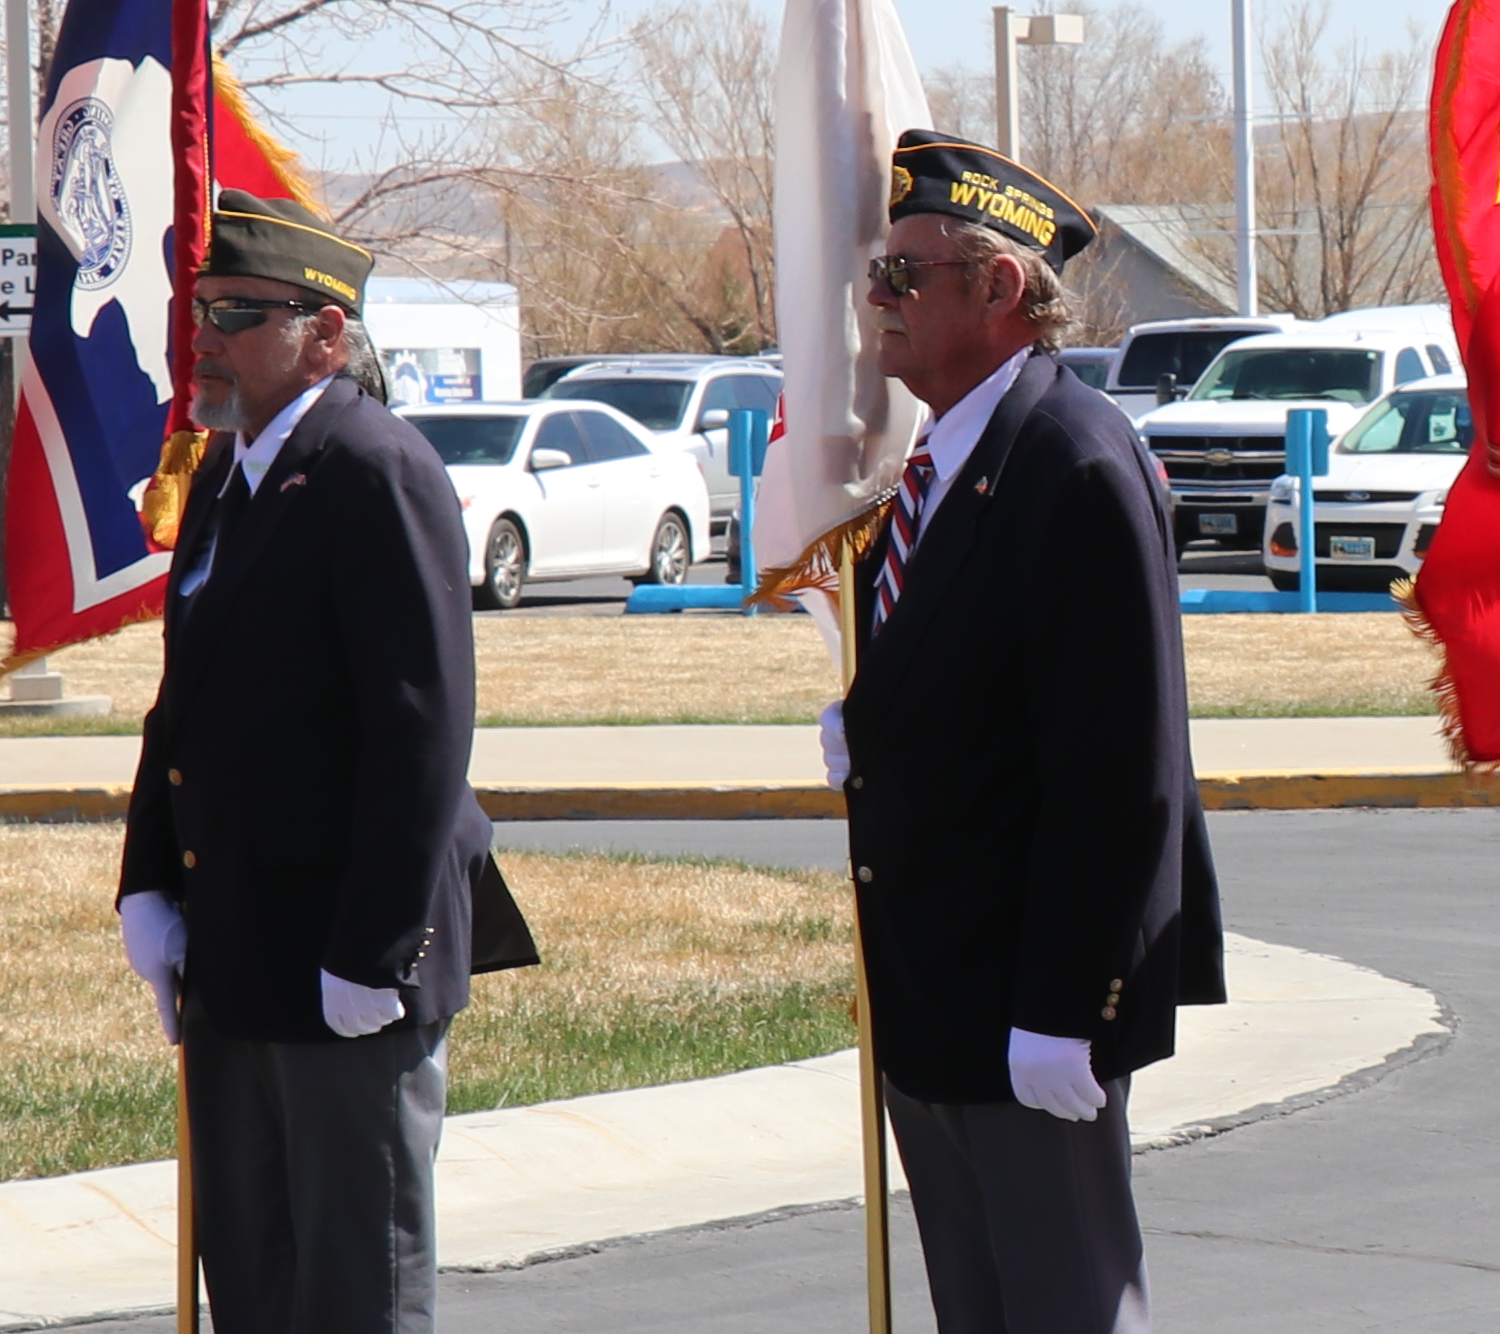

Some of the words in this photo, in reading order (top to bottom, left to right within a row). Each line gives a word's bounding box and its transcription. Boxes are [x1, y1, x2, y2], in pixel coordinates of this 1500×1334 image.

[950, 181, 1058, 246] WYOMING
[961, 170, 999, 191] ROCK
[1005, 185, 1056, 220] SPRINGS
[2, 248, 37, 267] Par
[304, 267, 357, 301] WYOMING
